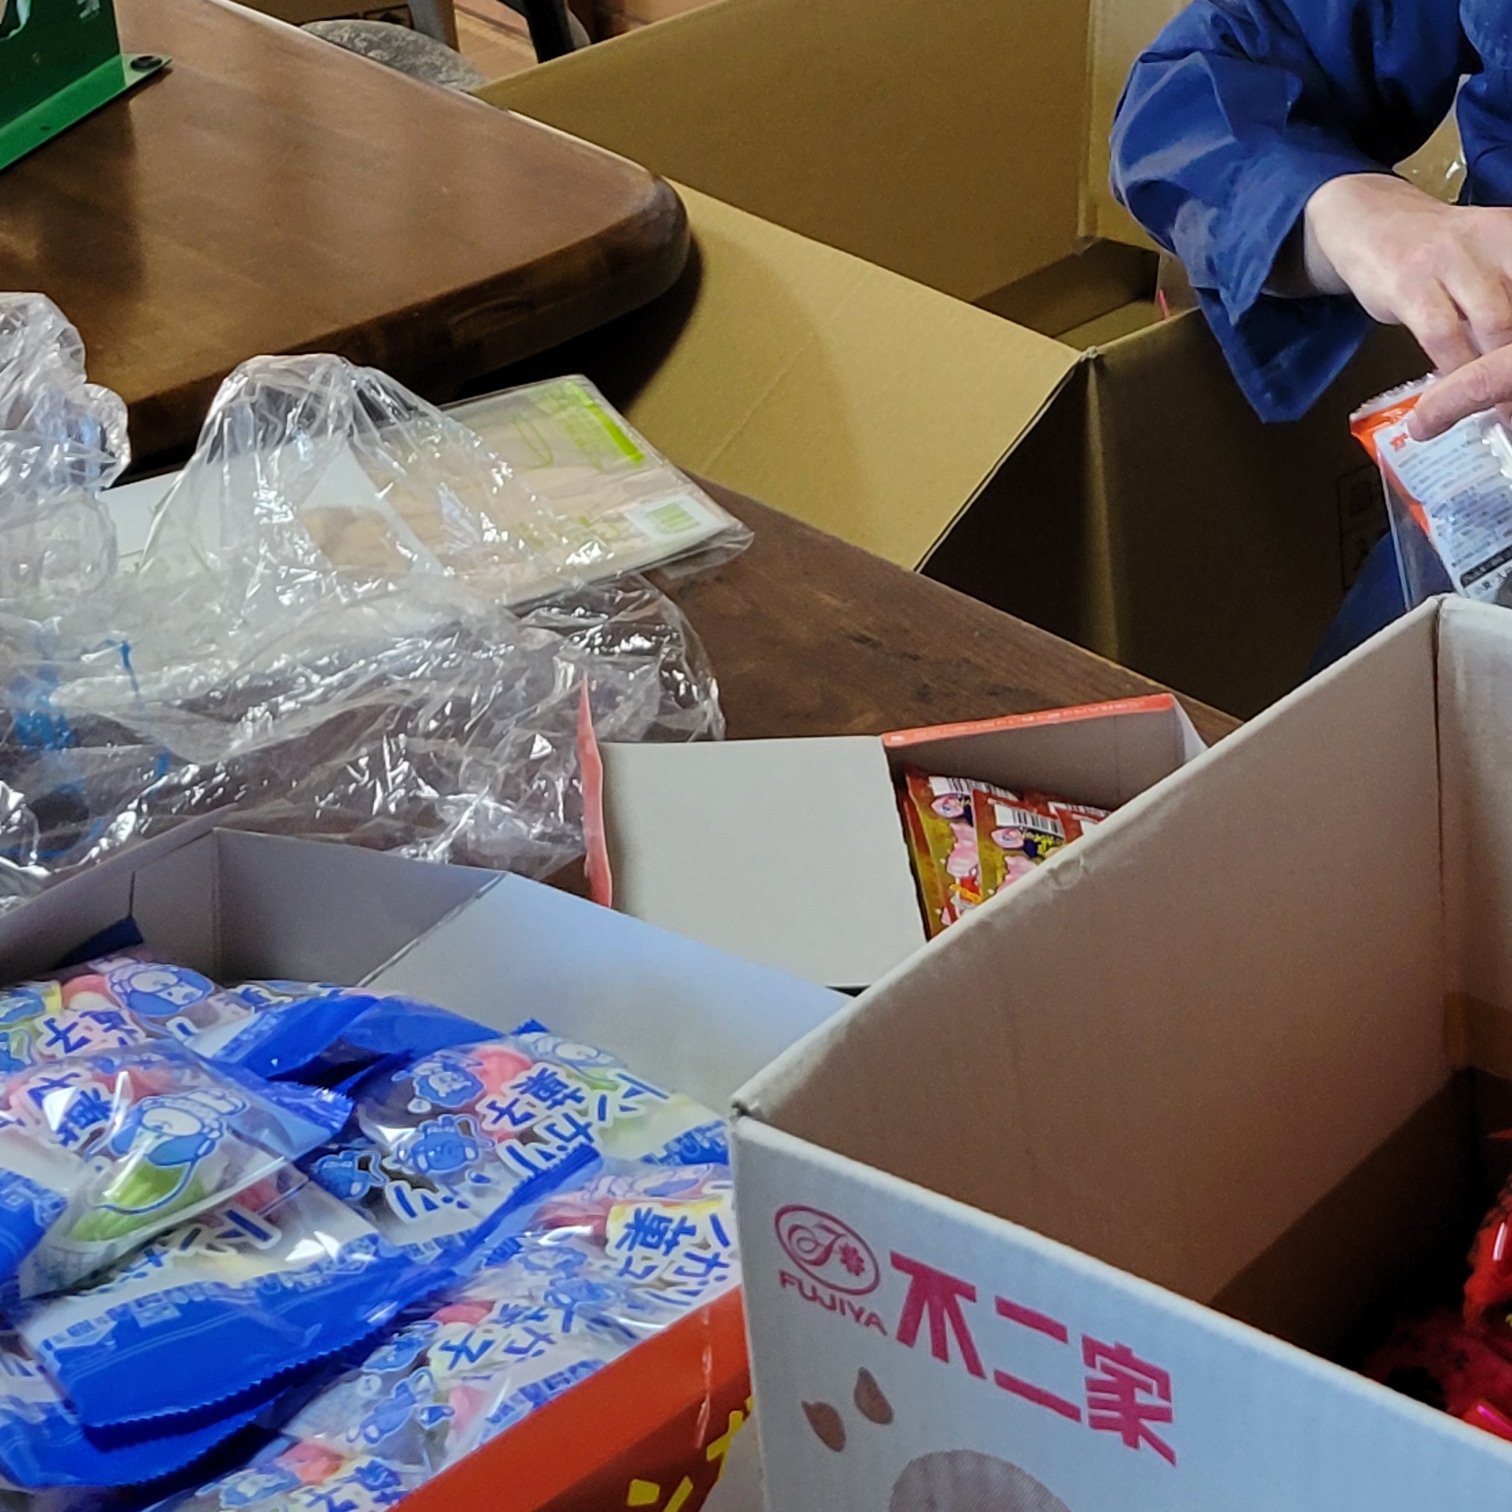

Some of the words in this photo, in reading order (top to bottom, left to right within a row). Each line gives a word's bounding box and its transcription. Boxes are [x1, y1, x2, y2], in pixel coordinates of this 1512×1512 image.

[489, 1068, 583, 1125] 菓子
[779, 1270, 887, 1336] FUJIYA
[890, 1250, 1176, 1467] 不二家
